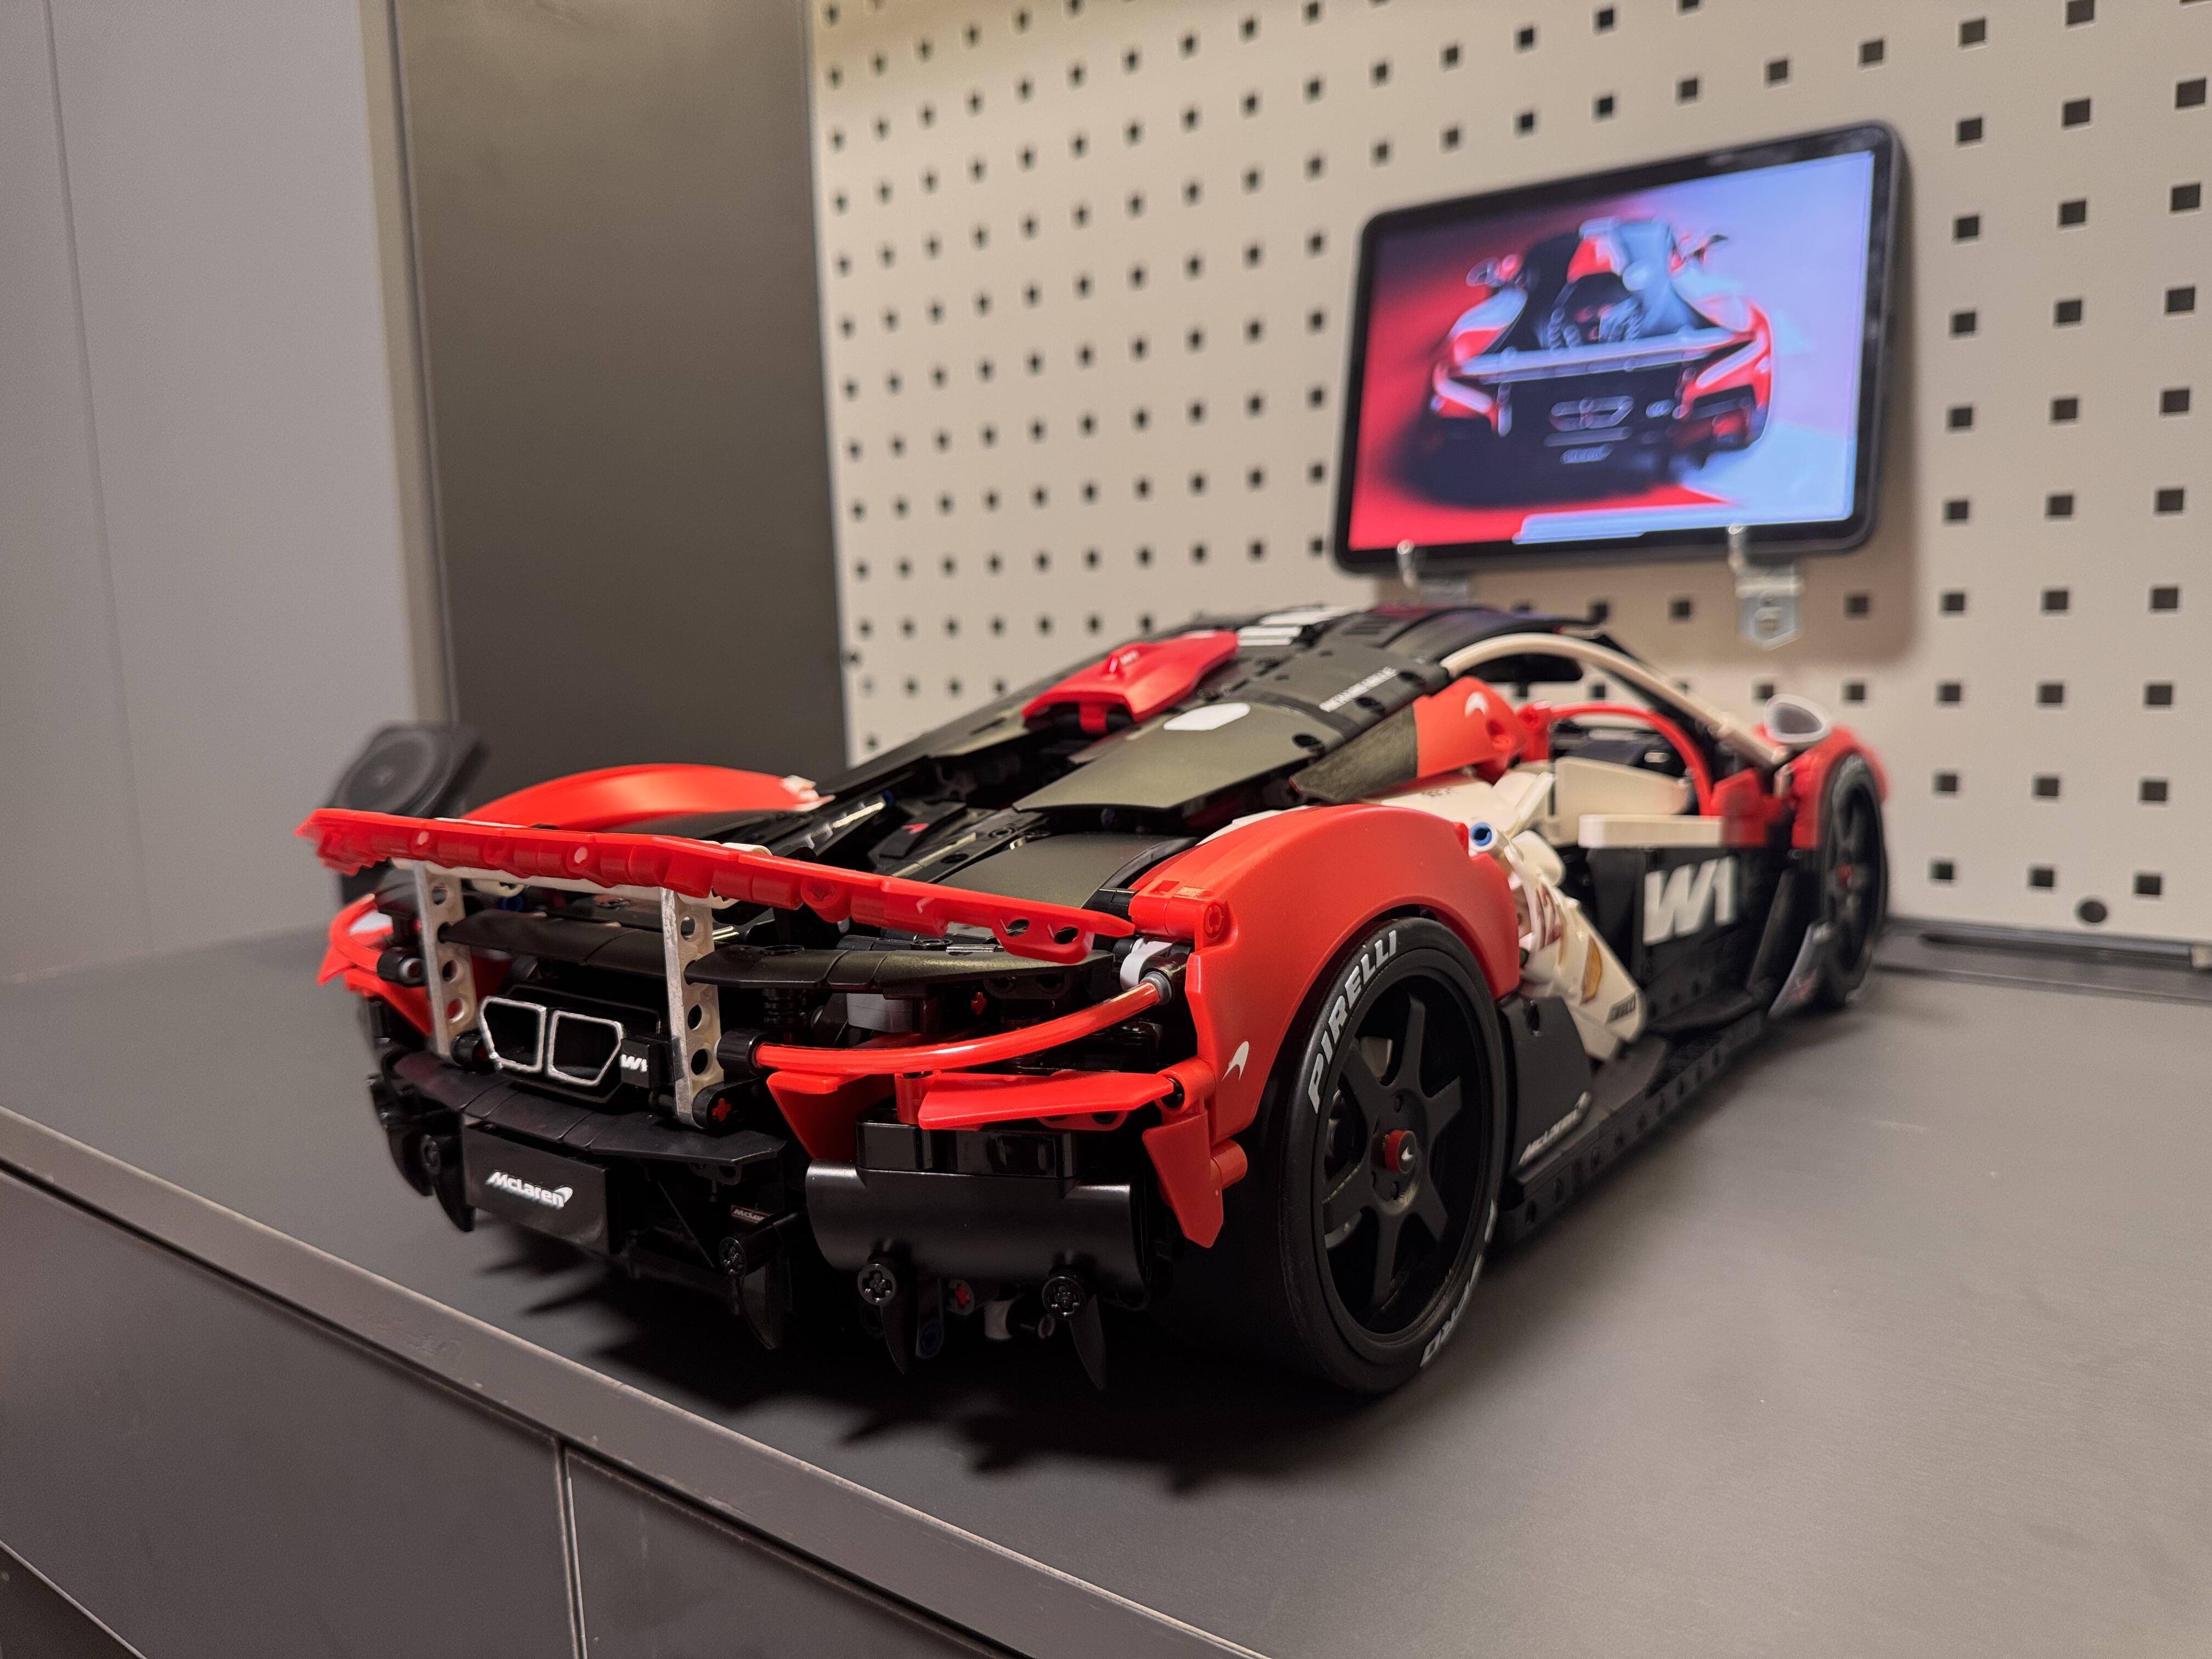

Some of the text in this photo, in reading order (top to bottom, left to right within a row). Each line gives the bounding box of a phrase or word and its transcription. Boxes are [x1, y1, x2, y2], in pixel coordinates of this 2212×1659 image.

[1643, 856, 1735, 945] W1
[1308, 929, 1397, 1114] PIRELLI
[620, 1054, 648, 1073] W1
[486, 1171, 566, 1209] McLaren
[733, 1208, 766, 1221] McLar
